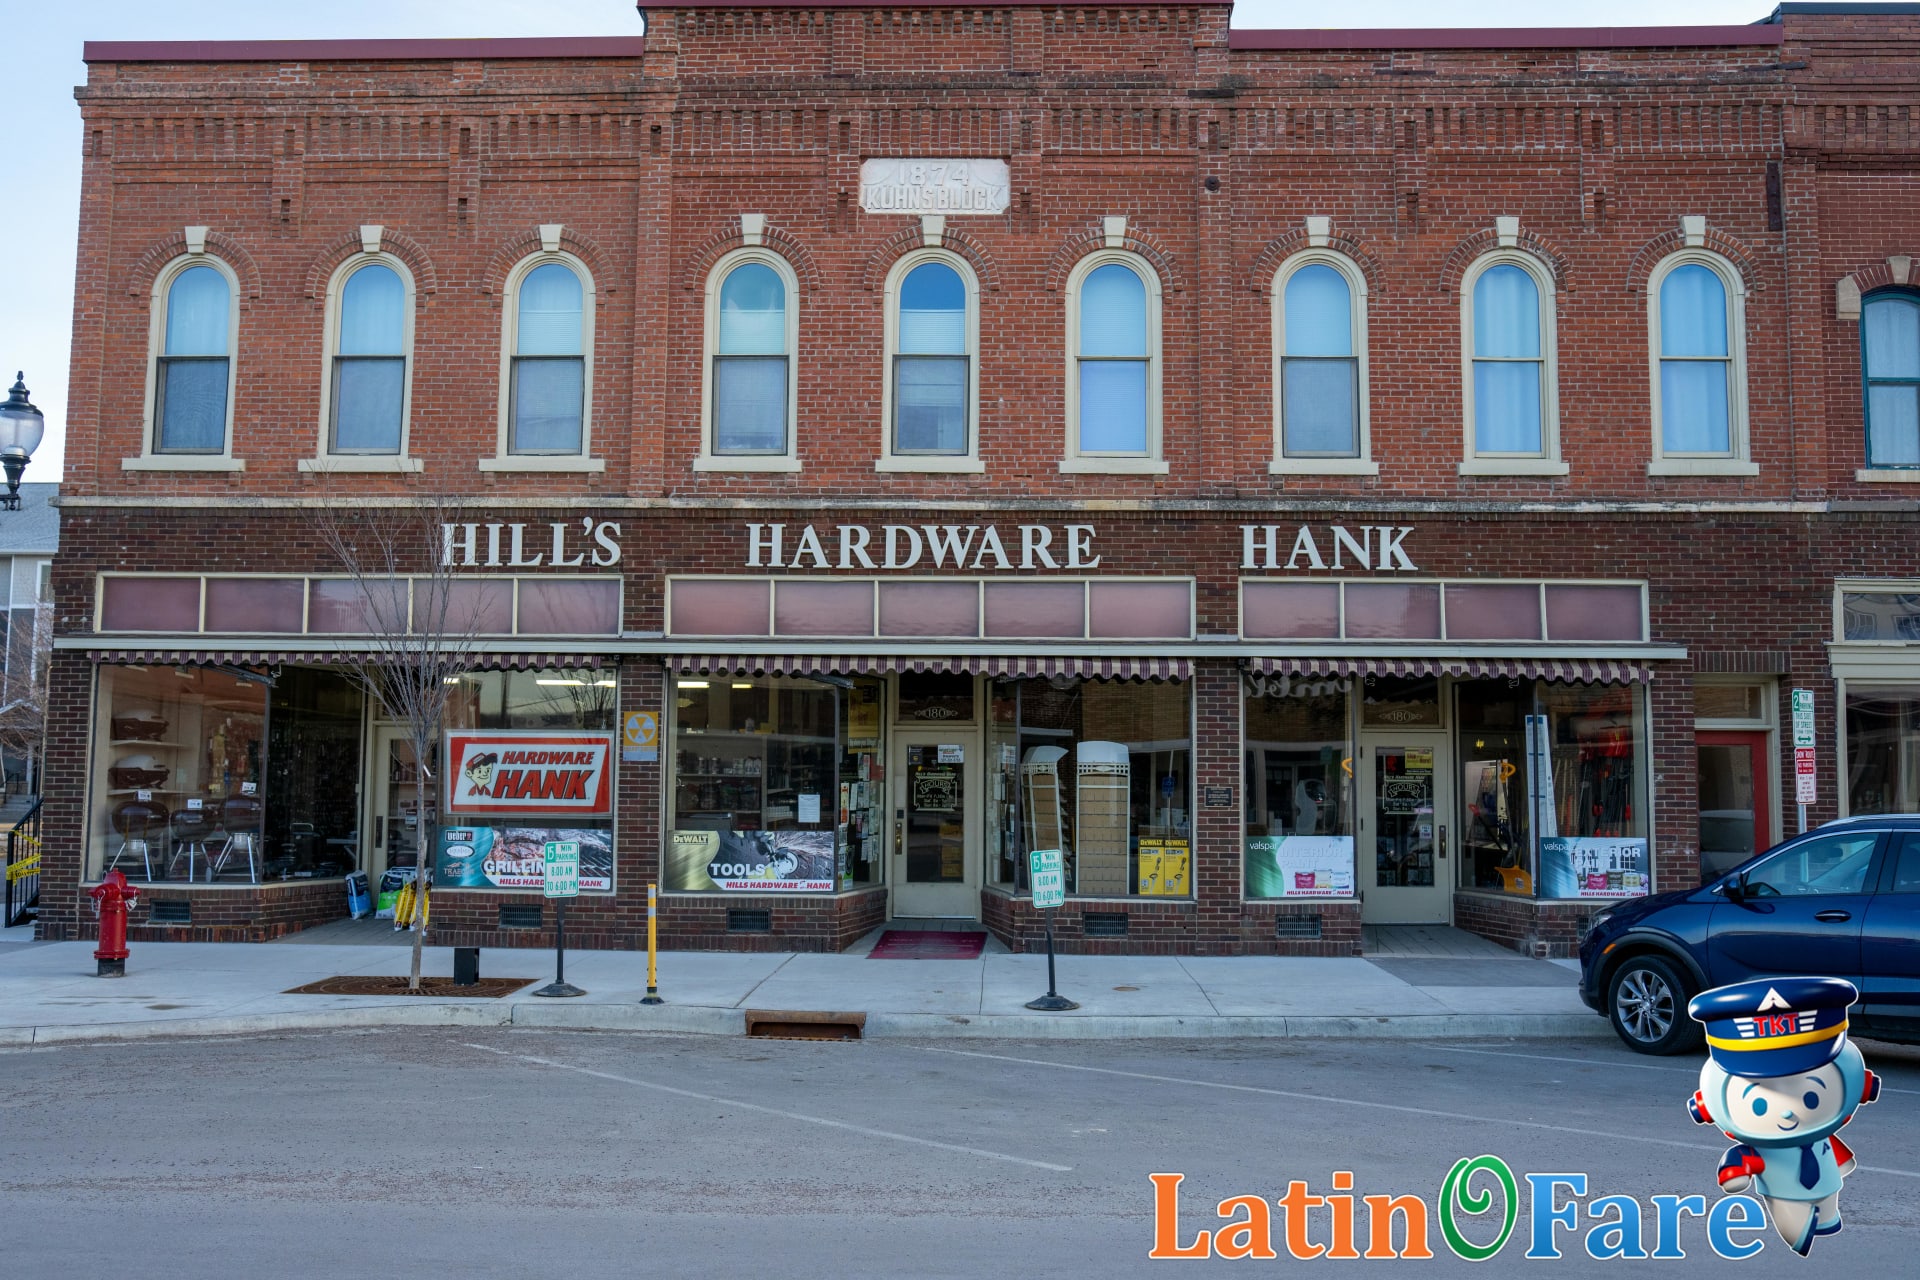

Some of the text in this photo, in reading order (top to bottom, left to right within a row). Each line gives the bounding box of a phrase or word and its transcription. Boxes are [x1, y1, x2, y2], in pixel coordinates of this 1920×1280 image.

[899, 162, 969, 186] 1874
[937, 186, 1002, 210] BLOCK
[440, 516, 1418, 571] HILL'S HARDWARE HANK
[1793, 694, 1799, 709] 2
[928, 708, 946, 719] 180
[1392, 710, 1411, 722] 180
[501, 750, 596, 765] HARDWARE
[491, 769, 596, 800] HANK
[547, 846, 555, 860] 15
[556, 853, 577, 861] PARKING
[483, 861, 545, 874] GRILLIN
[1032, 855, 1040, 870] 15
[565, 866, 573, 877] AM
[710, 863, 766, 876] TOOLS
[499, 878, 603, 888] HILLS HARD HANK
[547, 881, 554, 892] TO
[569, 880, 577, 890] PM
[725, 881, 831, 890] HILLS HARDWARE HANK
[1050, 875, 1058, 886] AM
[1035, 891, 1041, 901] TO
[1054, 889, 1062, 900] PM
